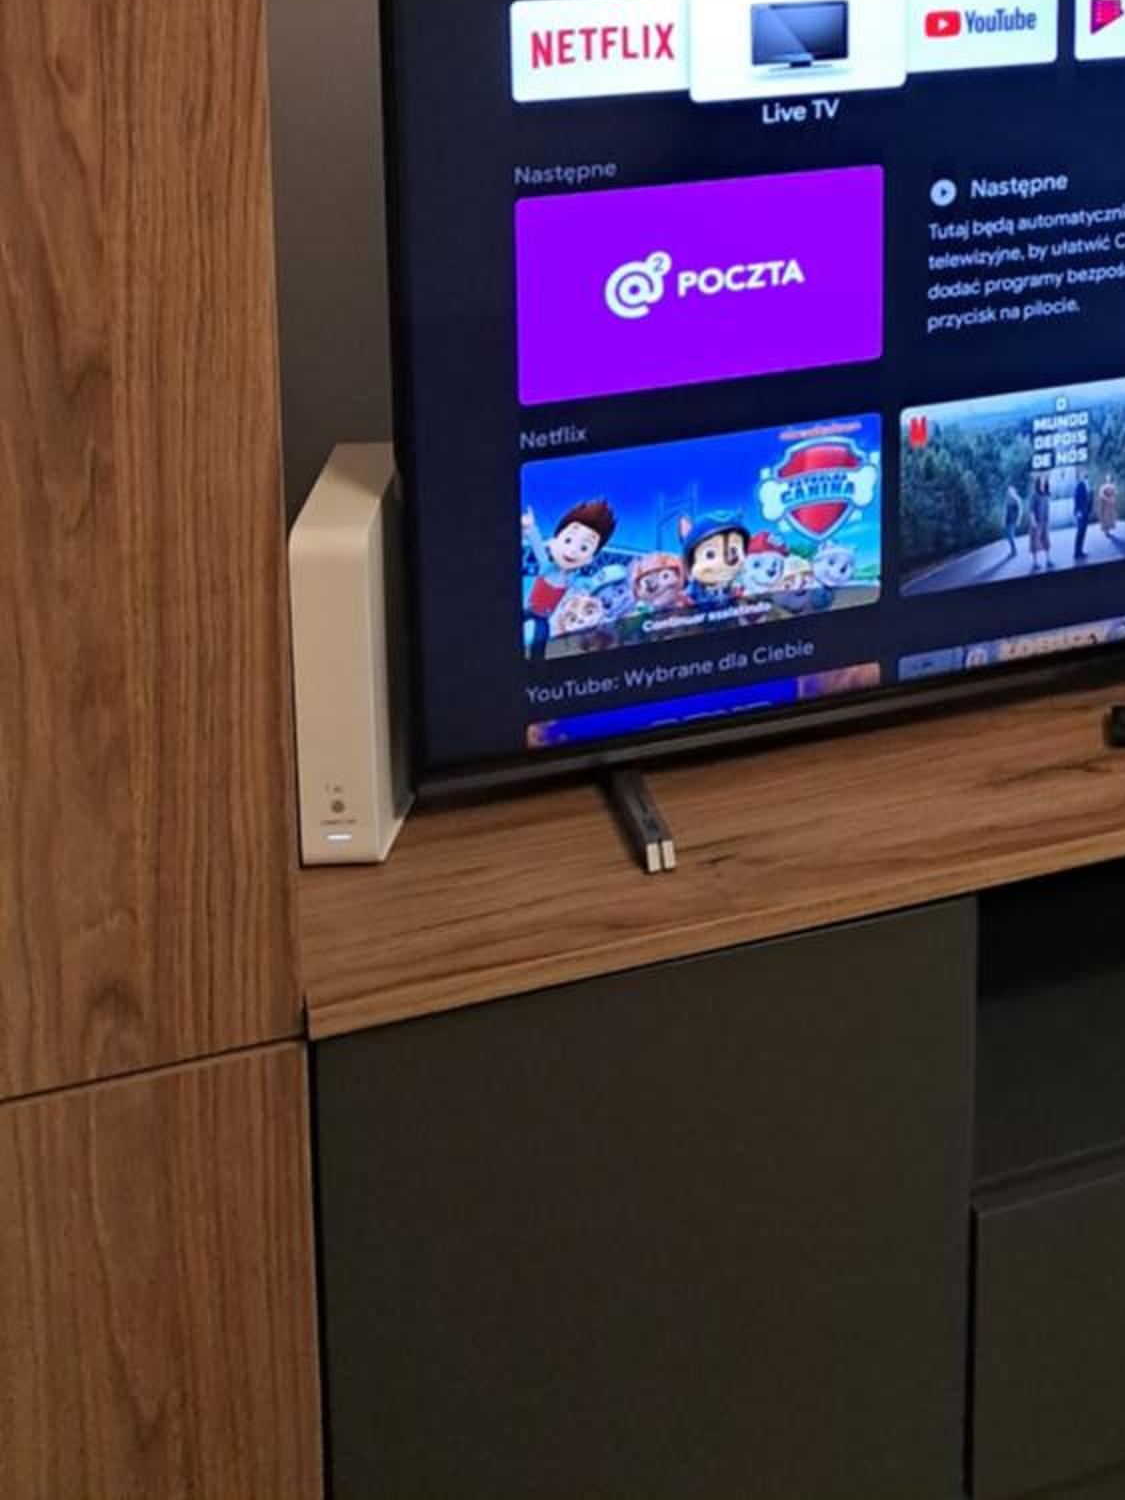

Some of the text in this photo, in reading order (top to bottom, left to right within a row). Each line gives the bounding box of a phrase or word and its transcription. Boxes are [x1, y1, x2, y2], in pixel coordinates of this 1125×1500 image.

[965, 9, 1037, 34] YouTube
[531, 23, 675, 68] NETFLIX
[762, 99, 839, 124] Live TV
[514, 162, 617, 186] Następne
[970, 175, 1068, 199] Następne
[928, 220, 970, 241] Tutaj
[972, 217, 1014, 238] będą
[928, 246, 1025, 271] telewizyjne,
[1028, 243, 1049, 262] by
[1051, 235, 1110, 256] ułatwić
[677, 259, 804, 297] POCZTA
[927, 278, 981, 300] dodać
[984, 272, 1064, 297] programy
[927, 296, 1080, 333] przycisk na pilocie.
[1033, 411, 1089, 433] MUNDO
[519, 424, 587, 450] Netflix
[1034, 429, 1087, 451] DEPOIS
[1032, 453, 1051, 468] DE
[781, 481, 856, 504] CANINA
[526, 640, 815, 705] YouTube: Wybrane dla Ciebie
